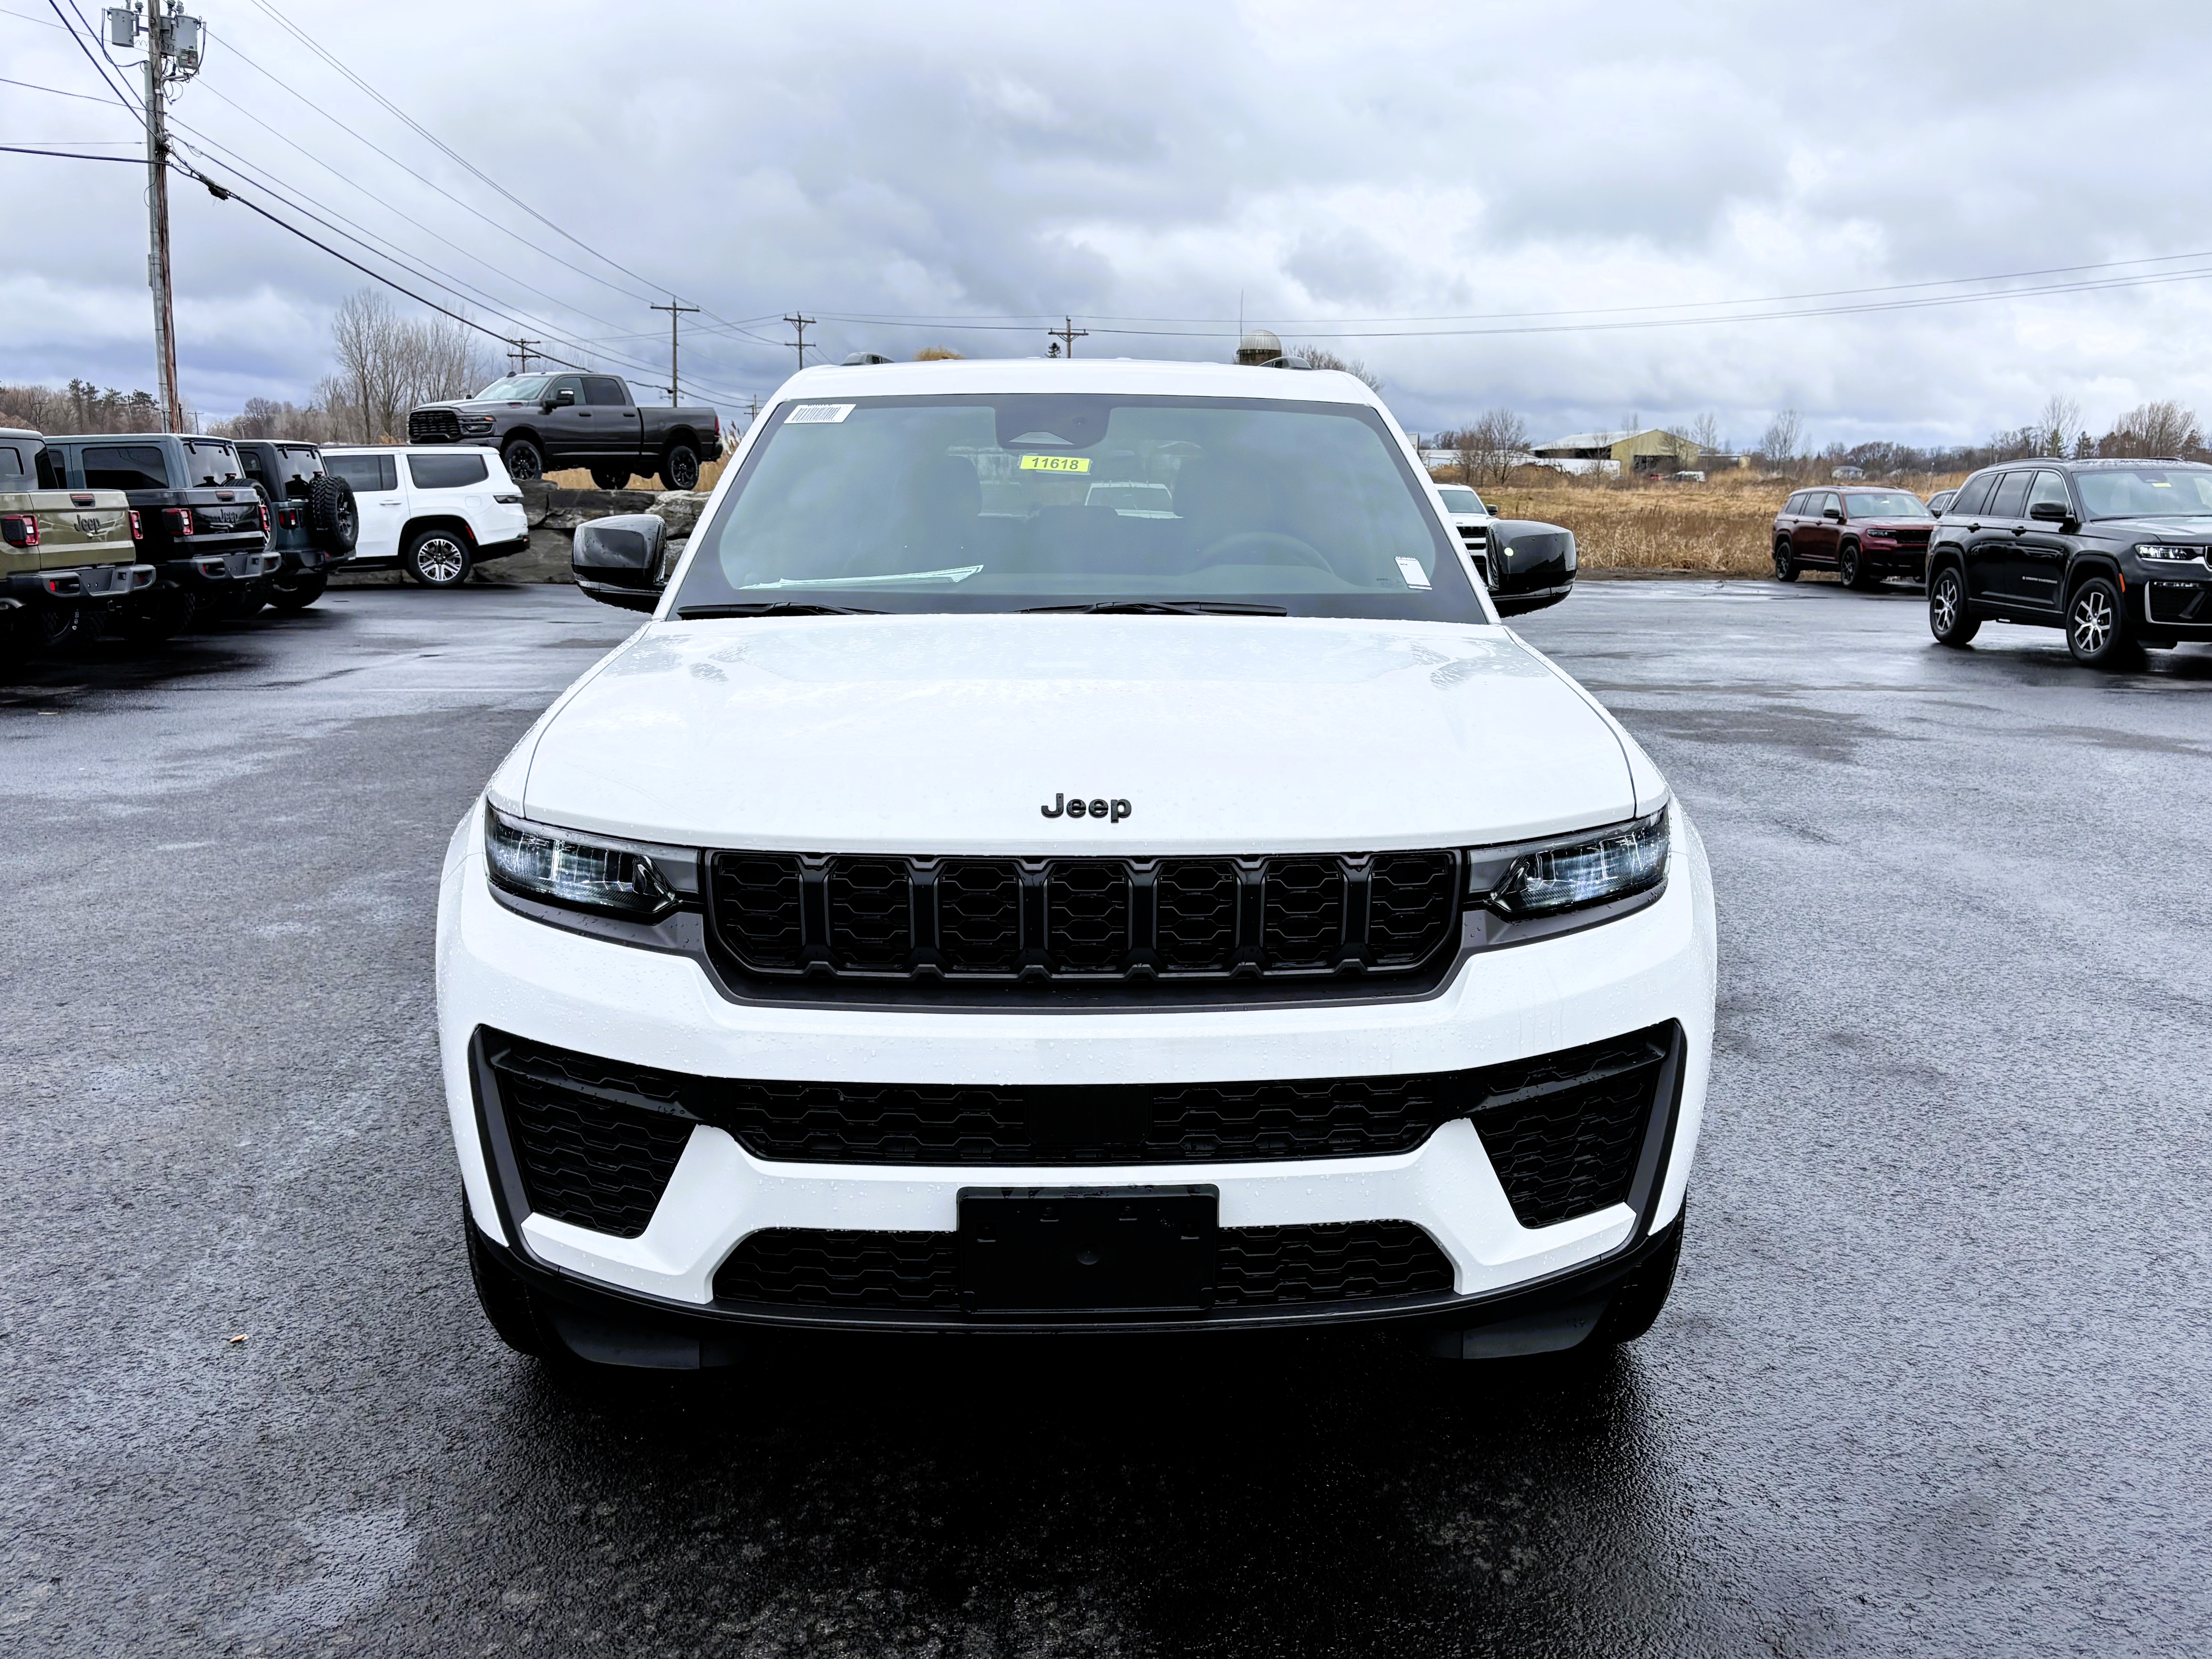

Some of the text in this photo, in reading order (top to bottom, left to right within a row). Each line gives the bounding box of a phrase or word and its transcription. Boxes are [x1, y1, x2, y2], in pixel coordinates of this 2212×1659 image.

[1032, 457, 1078, 470] 11618
[74, 514, 100, 534] Jeep
[1041, 793, 1132, 823] Jeep
